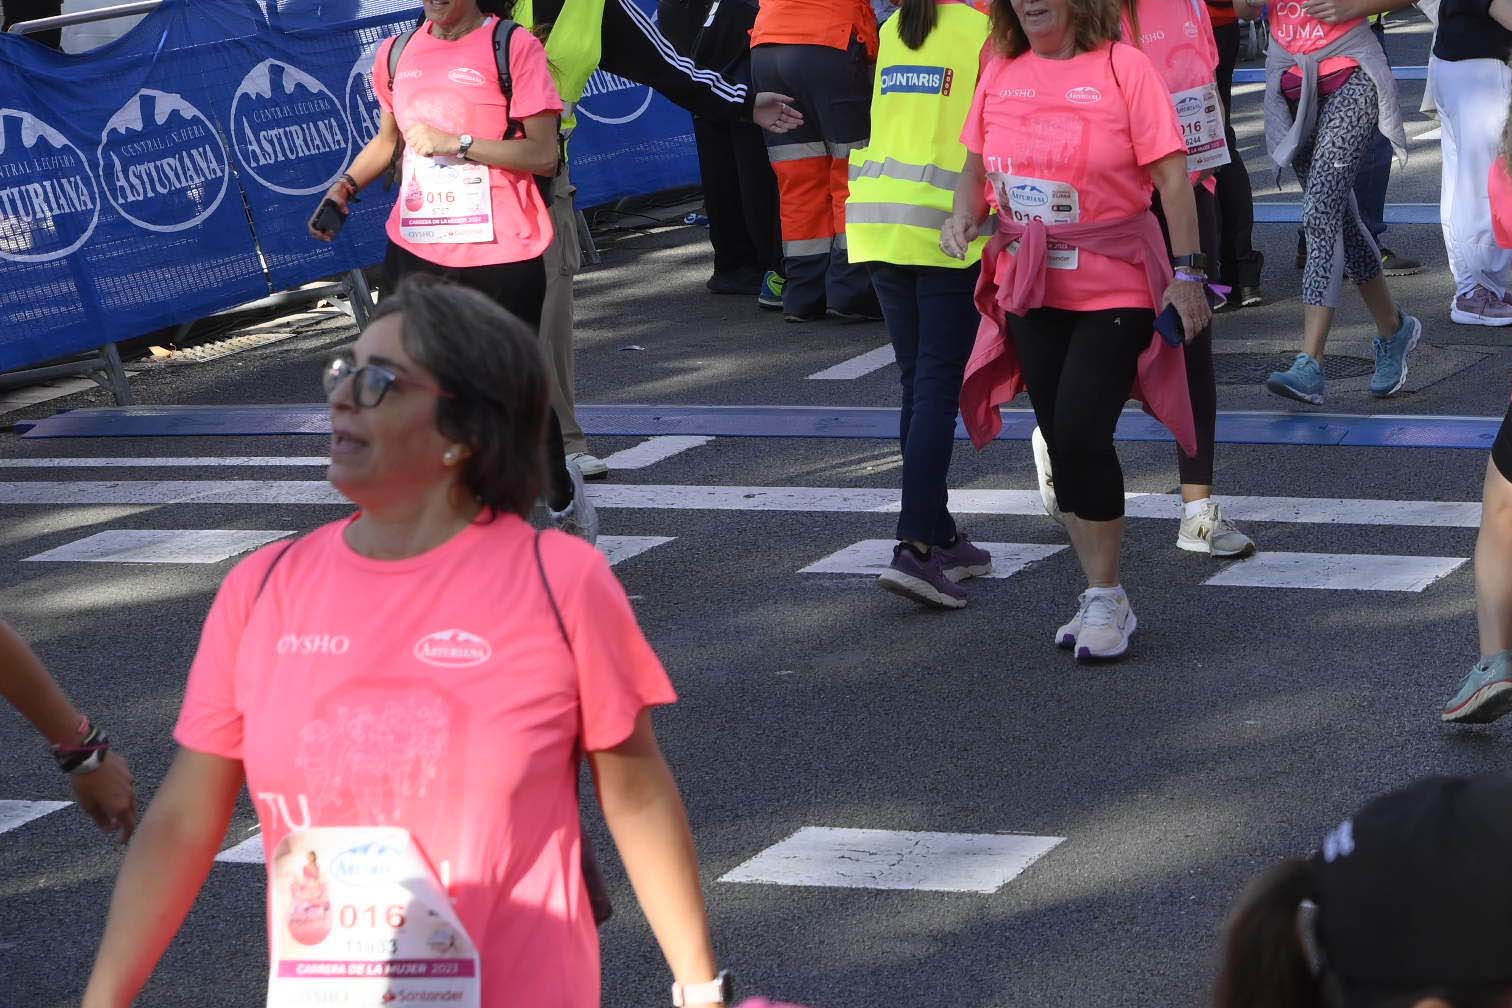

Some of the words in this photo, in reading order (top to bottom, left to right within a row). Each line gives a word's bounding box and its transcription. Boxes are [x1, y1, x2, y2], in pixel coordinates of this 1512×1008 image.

[999, 89, 1036, 99] OYSHO
[253, 103, 292, 124] CENTRAL
[121, 133, 164, 158] CENTRAL
[243, 114, 346, 168] ASTURIANA
[113, 145, 225, 206] ASTURIANA
[987, 155, 1013, 174] TU
[427, 191, 456, 204] 016
[276, 634, 350, 657] OYSHO
[258, 792, 312, 833] TU
[340, 904, 408, 929] 016
[398, 990, 464, 1003] Santander
